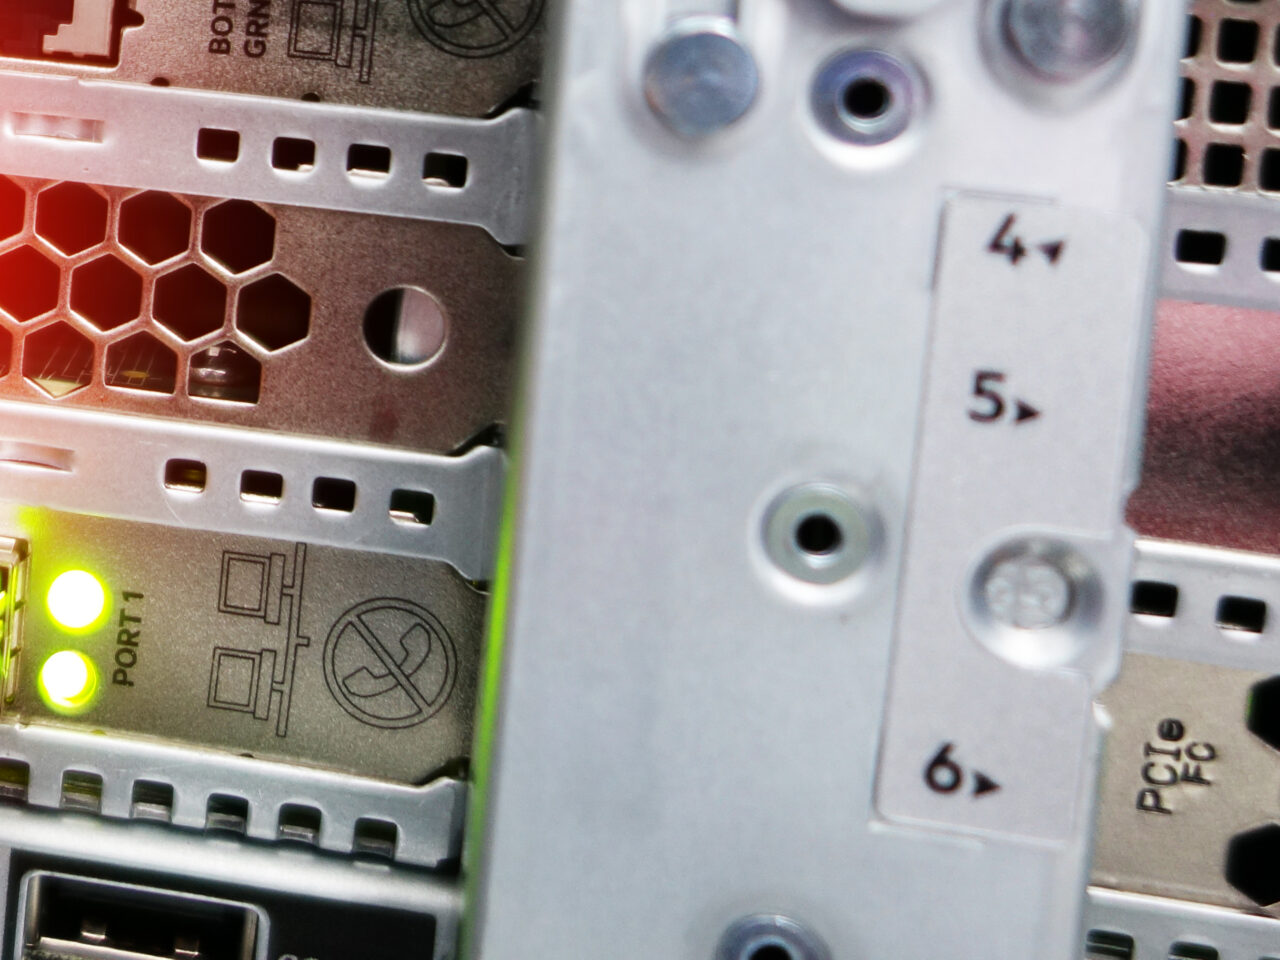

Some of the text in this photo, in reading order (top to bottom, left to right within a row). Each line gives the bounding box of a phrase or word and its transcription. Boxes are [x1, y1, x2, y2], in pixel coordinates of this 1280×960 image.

[988, 212, 1027, 265] 4
[968, 371, 1006, 424] 5
[112, 591, 144, 687] PORT 1
[924, 742, 964, 796] 6
[1136, 719, 1185, 815] PCIe
[1181, 742, 1217, 786] FC
